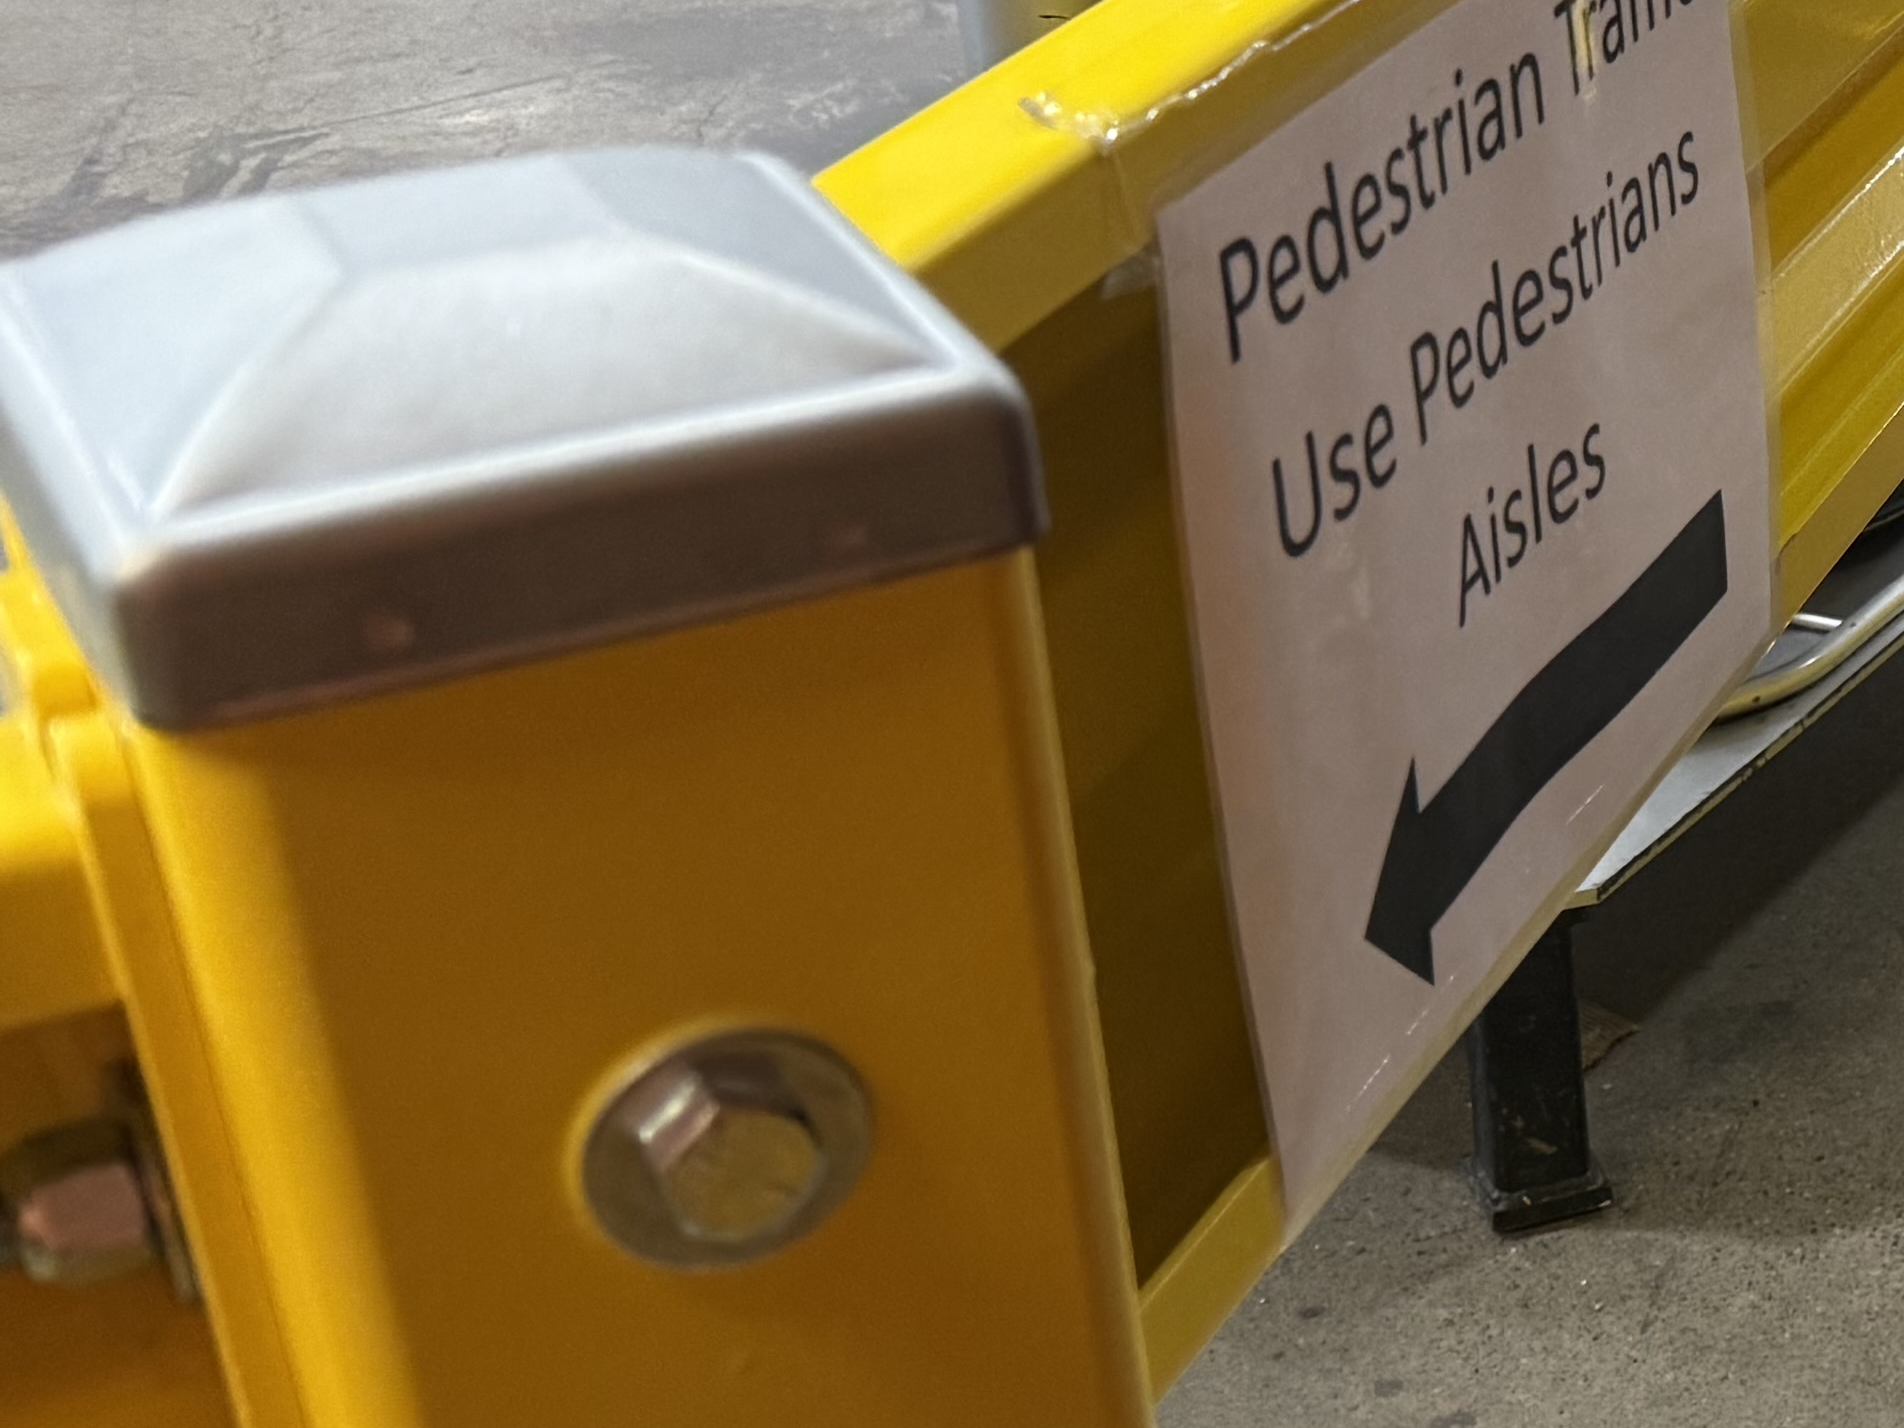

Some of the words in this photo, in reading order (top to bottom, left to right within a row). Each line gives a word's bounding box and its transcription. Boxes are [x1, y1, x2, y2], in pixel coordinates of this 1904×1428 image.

[1218, 68, 1546, 366] Pedestrian
[1271, 404, 1398, 560] Use
[1409, 130, 1701, 447] Pedestrians
[1458, 422, 1608, 630] Aisles
